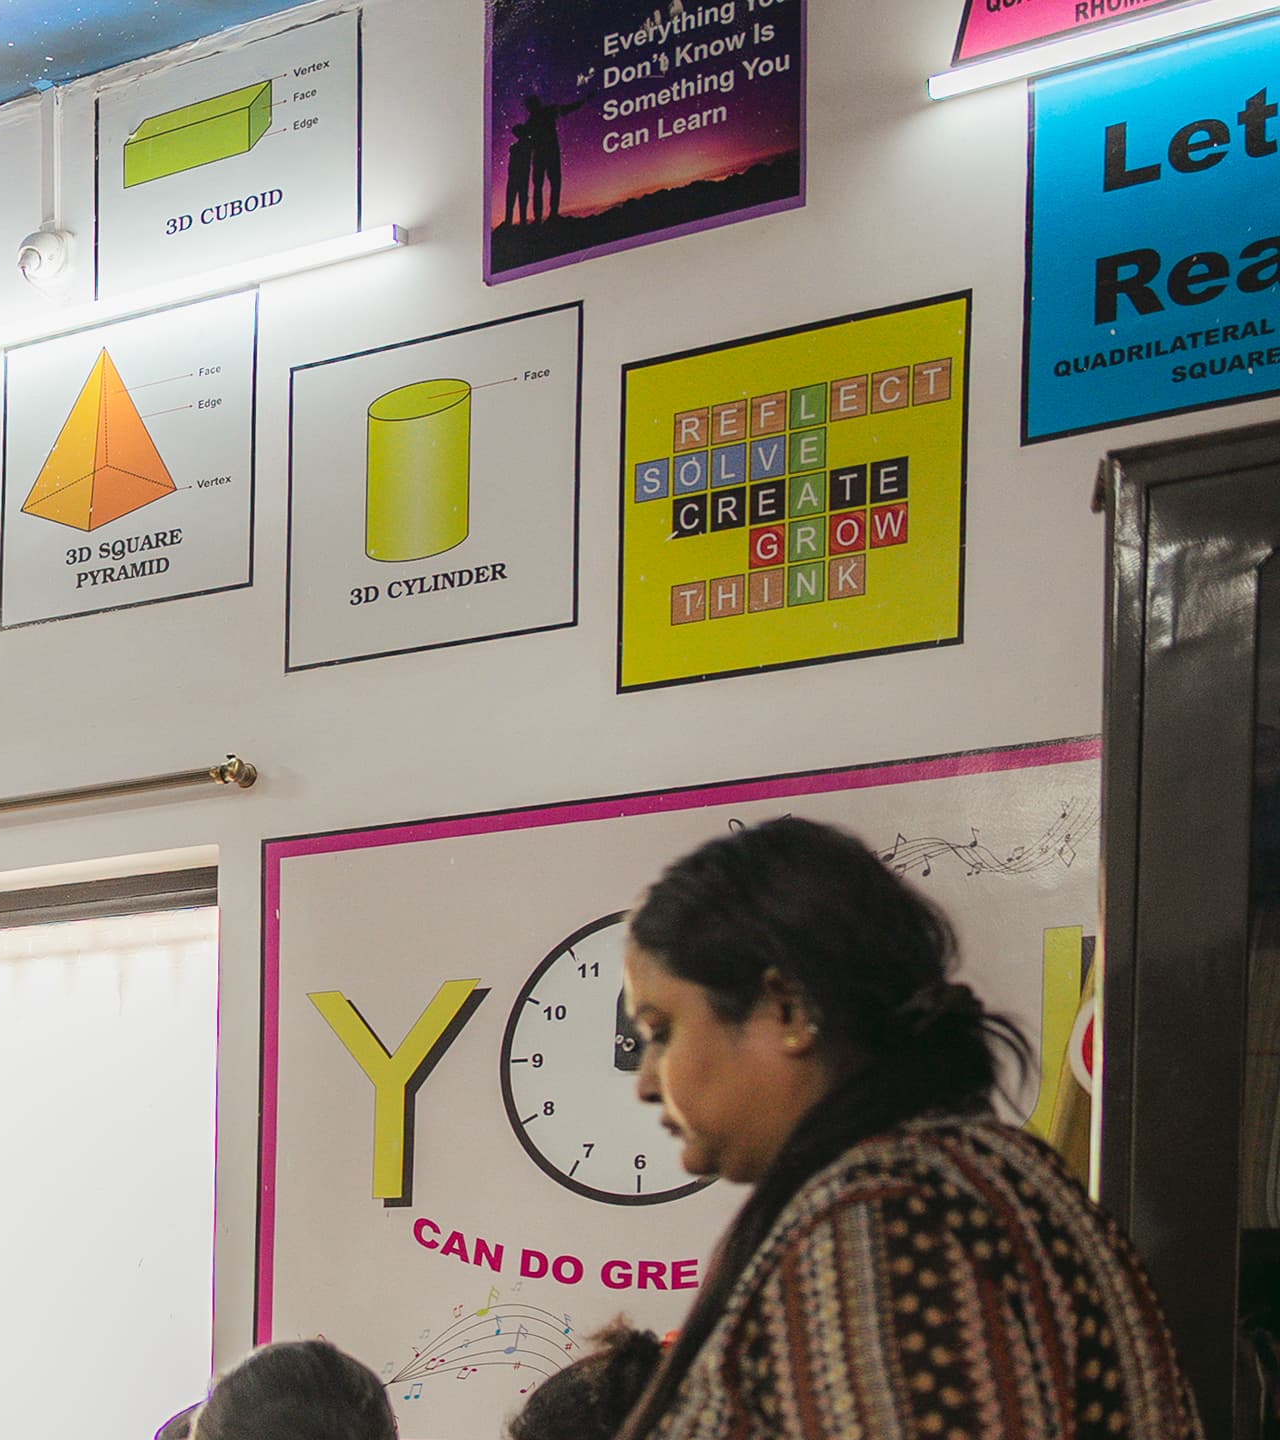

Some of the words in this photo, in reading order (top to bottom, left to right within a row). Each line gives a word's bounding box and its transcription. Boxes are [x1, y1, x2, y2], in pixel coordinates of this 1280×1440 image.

[603, 1, 736, 56] Everything
[675, 32, 746, 67] Know
[753, 23, 775, 44] Is
[292, 60, 330, 77] Vertex
[603, 69, 734, 121] Something
[742, 54, 790, 80] You
[292, 87, 317, 103] Face
[292, 115, 319, 132] Edge
[602, 127, 649, 153] Can
[658, 106, 727, 139] Learn
[1103, 86, 1278, 192] Let
[164, 212, 194, 236] 3D
[199, 188, 284, 229] CUBOID
[1053, 318, 1275, 378] QUADRILATERAL
[198, 364, 222, 378] Face
[523, 367, 551, 383] Face
[197, 396, 223, 413] Edge
[678, 364, 944, 446] REFLECT
[196, 474, 233, 490] Vertex
[641, 434, 819, 495] SOLVE
[678, 465, 900, 531] CREATE
[65, 545, 93, 567] 3D
[98, 528, 184, 561] SQUARE
[754, 508, 907, 558] GROW
[75, 556, 171, 590] PYRAMID
[350, 583, 381, 606] 3D
[386, 561, 508, 601] CYLINDER
[677, 560, 859, 618] THINK
[577, 962, 600, 978] 11
[543, 1005, 567, 1021] 10
[531, 1053, 544, 1068] 9
[543, 1101, 555, 1116] 8
[582, 1143, 595, 1158] 7
[634, 1154, 647, 1170] 6
[412, 1217, 504, 1273] CAN
[520, 1248, 584, 1285] DO
[600, 1259, 699, 1290] GRE
